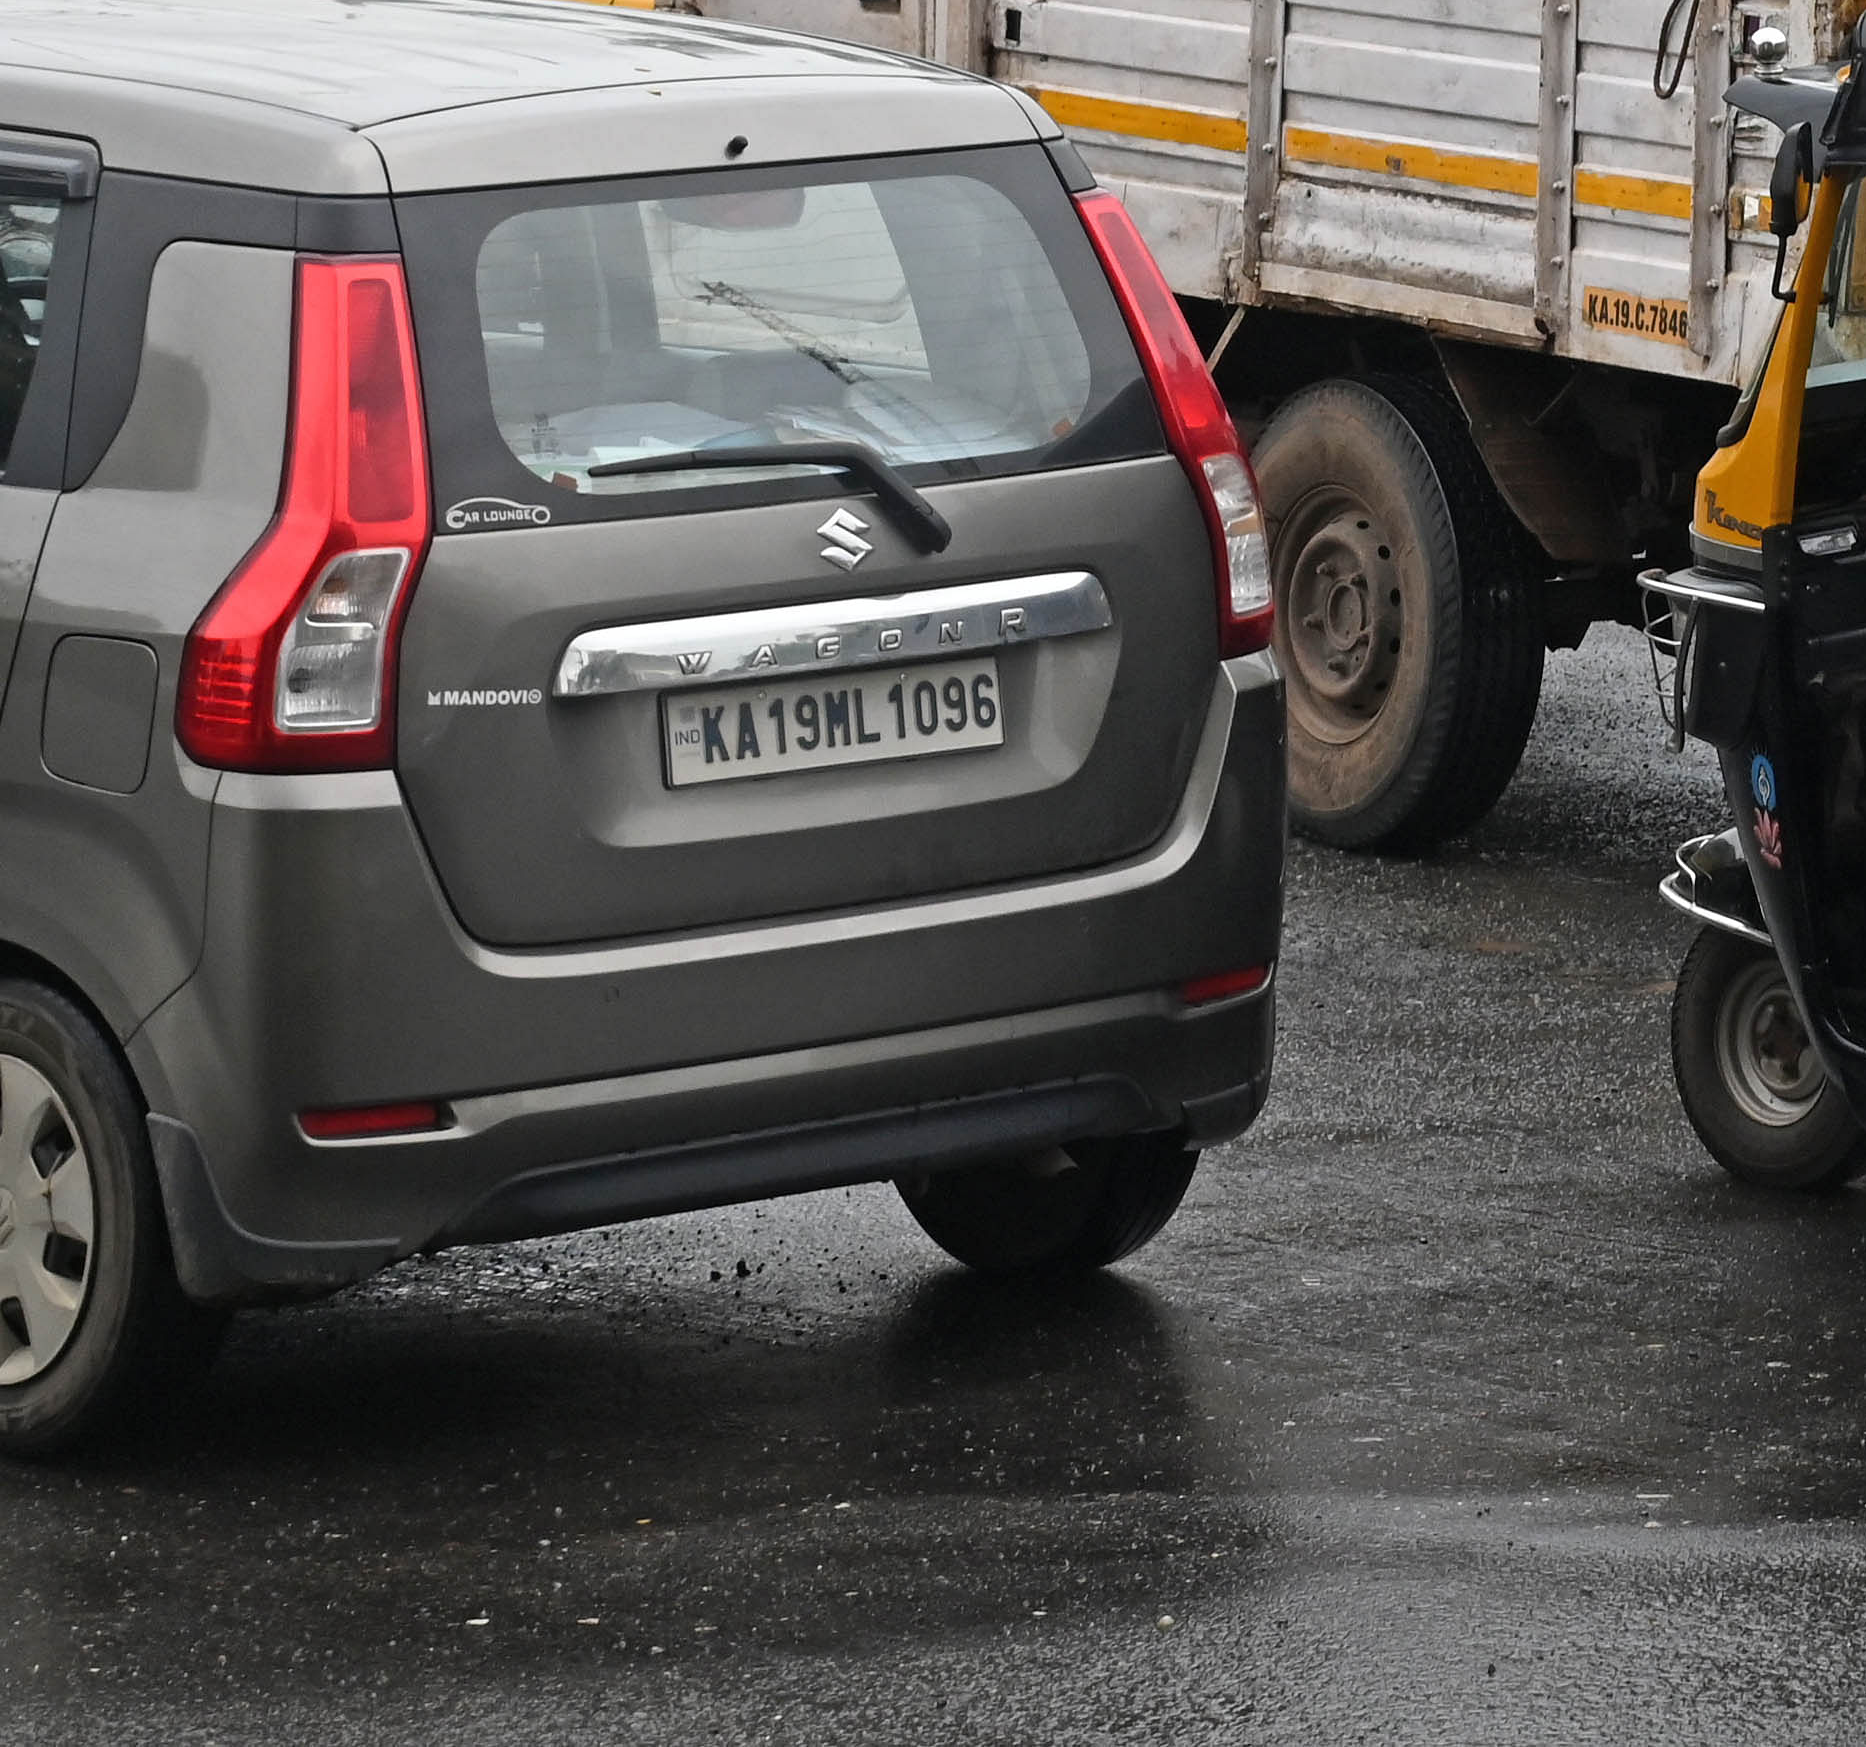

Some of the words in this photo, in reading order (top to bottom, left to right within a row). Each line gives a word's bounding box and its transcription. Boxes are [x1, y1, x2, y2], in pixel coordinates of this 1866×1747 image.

[1588, 294, 1688, 339] KA.19.C.7846
[483, 509, 531, 523] LOUNGE
[443, 690, 528, 705] MANDOVI
[702, 674, 997, 764] KA19ML1096
[674, 729, 700, 746] IND
